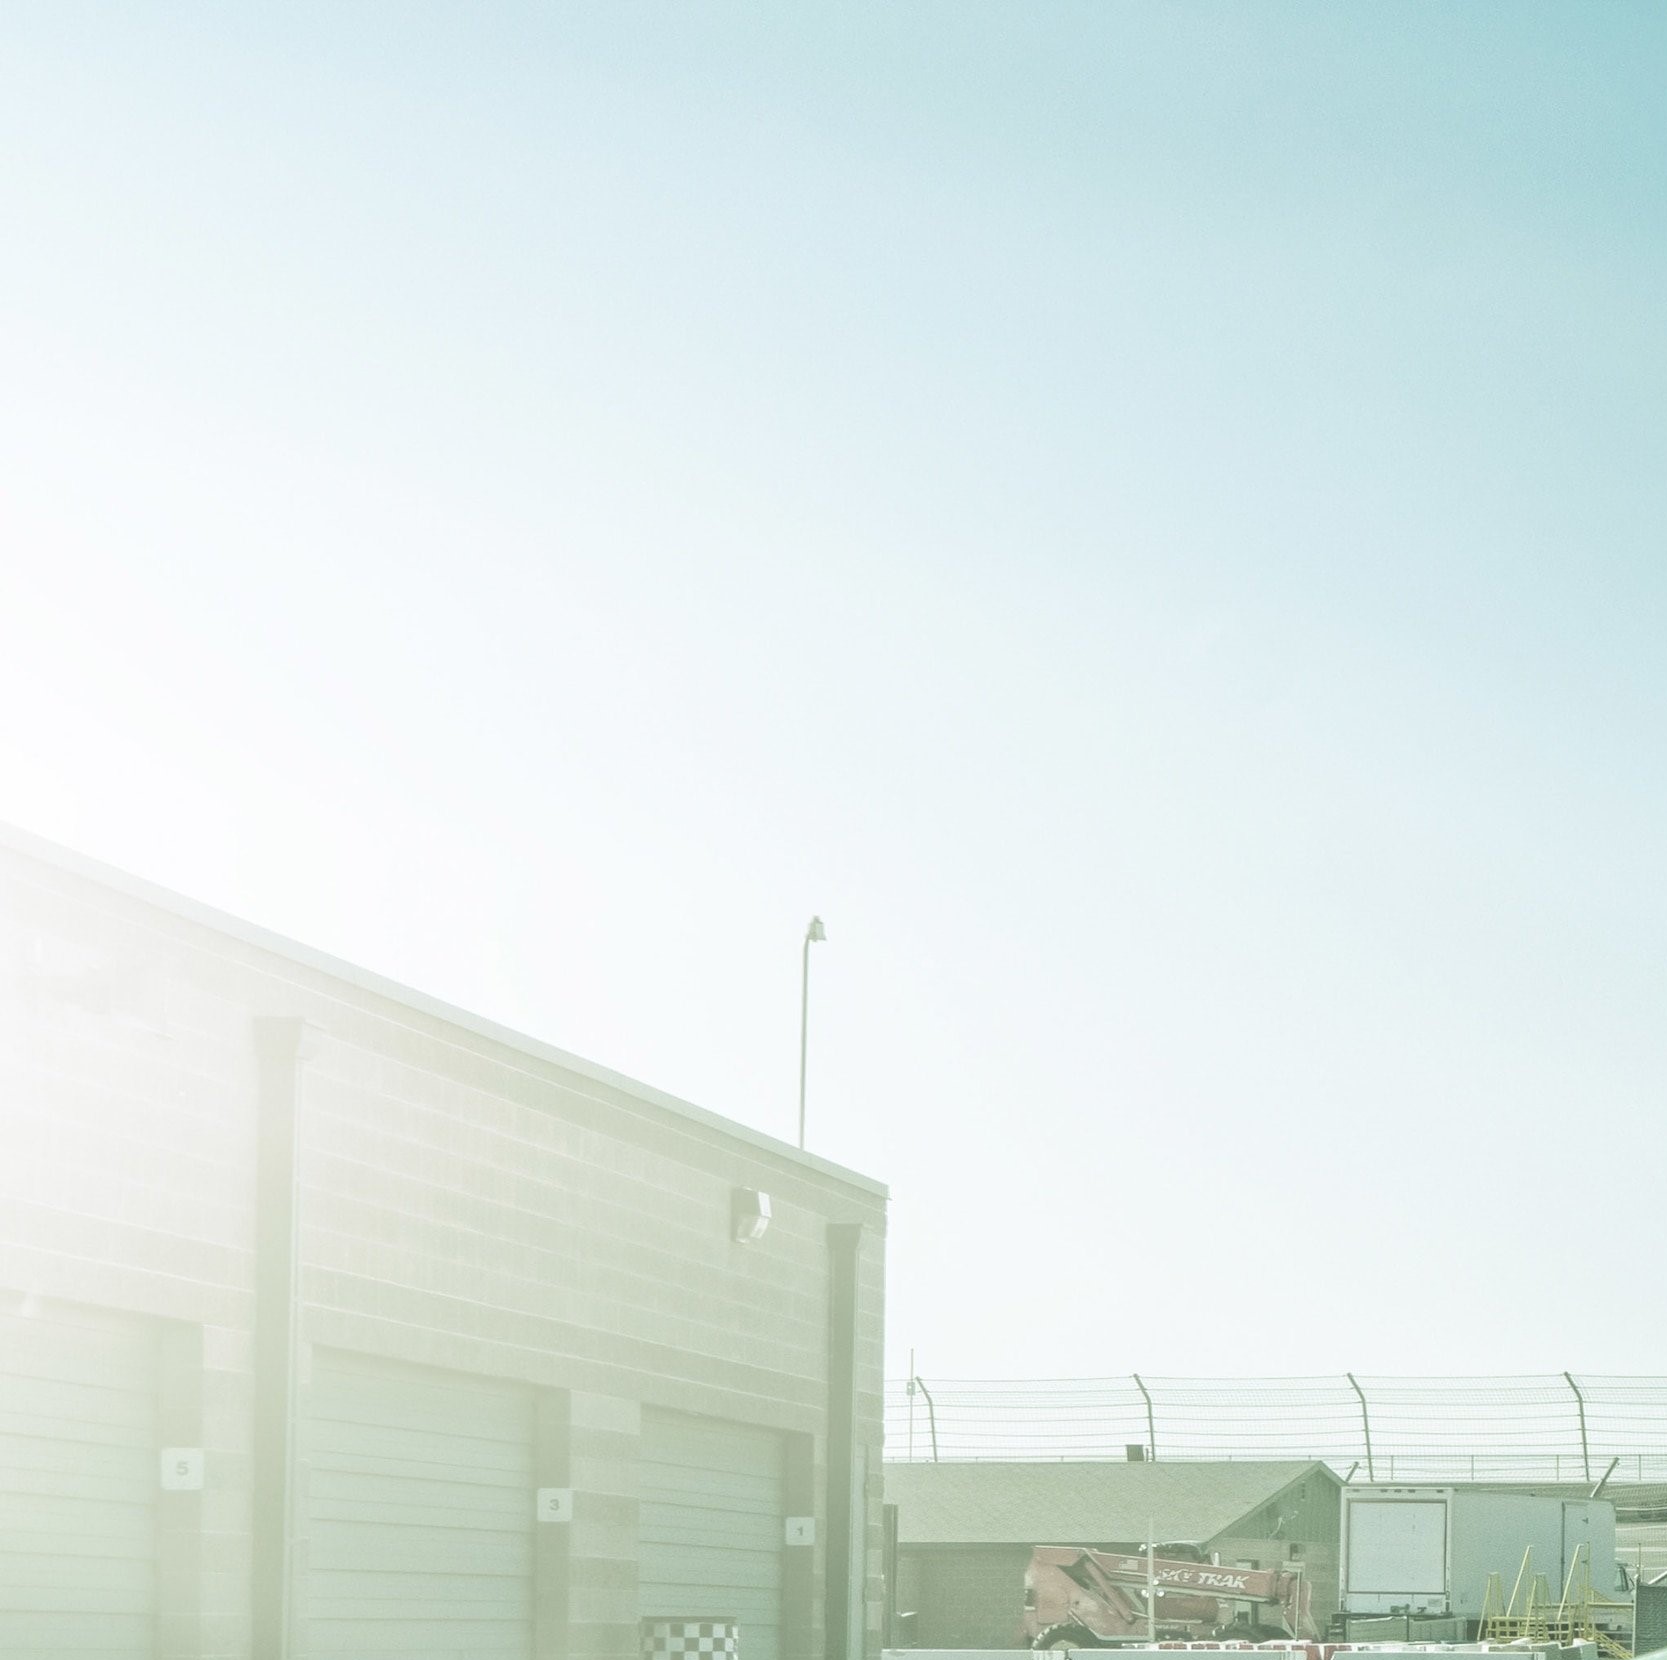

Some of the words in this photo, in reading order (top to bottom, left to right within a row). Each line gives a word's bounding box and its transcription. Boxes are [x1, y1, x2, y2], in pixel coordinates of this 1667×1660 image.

[175, 1460, 189, 1476] 5
[549, 1499, 560, 1511] 3
[1198, 1571, 1250, 1589] TRAK
